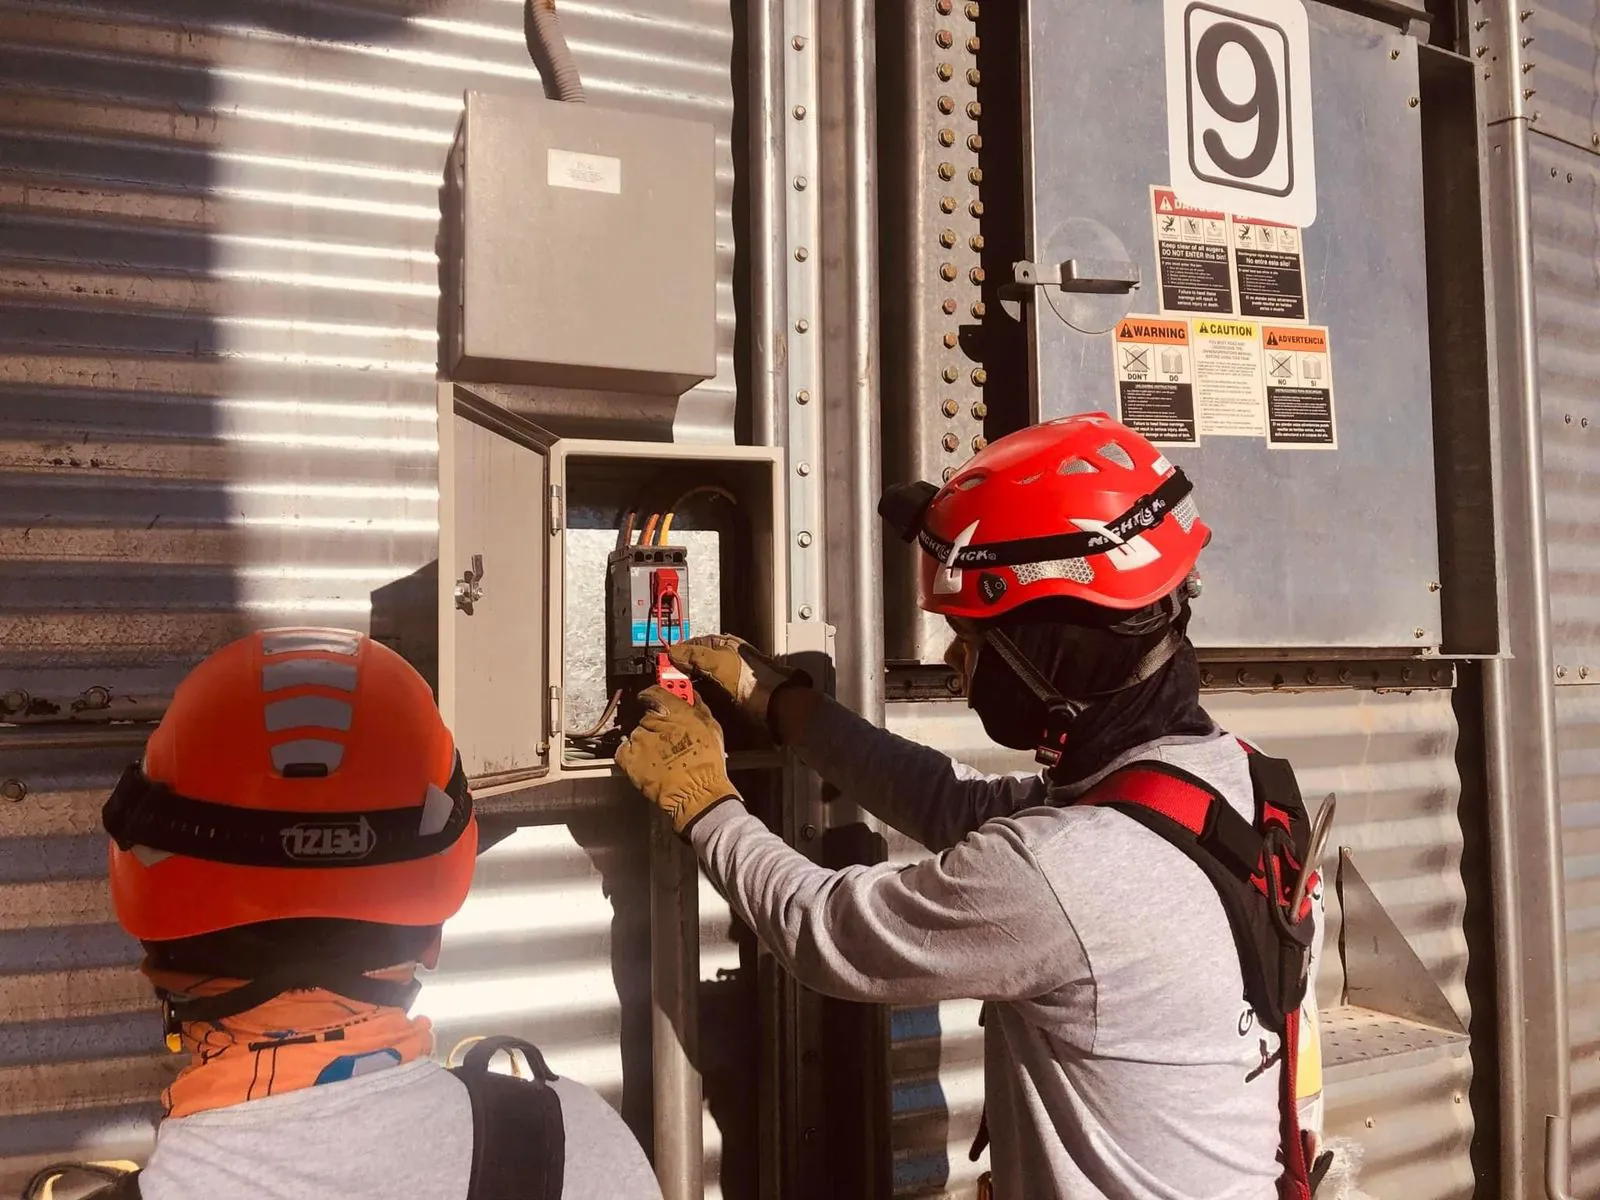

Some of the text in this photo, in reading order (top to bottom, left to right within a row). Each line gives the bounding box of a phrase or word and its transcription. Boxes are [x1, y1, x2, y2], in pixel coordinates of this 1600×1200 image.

[1196, 21, 1279, 178] 9
[1133, 325, 1186, 339] WARNING
[1210, 324, 1252, 336] CAUTION
[1278, 335, 1324, 345] ADVERTENCIA
[983, 580, 994, 599] VISOR
[280, 815, 369, 855] PETZL
